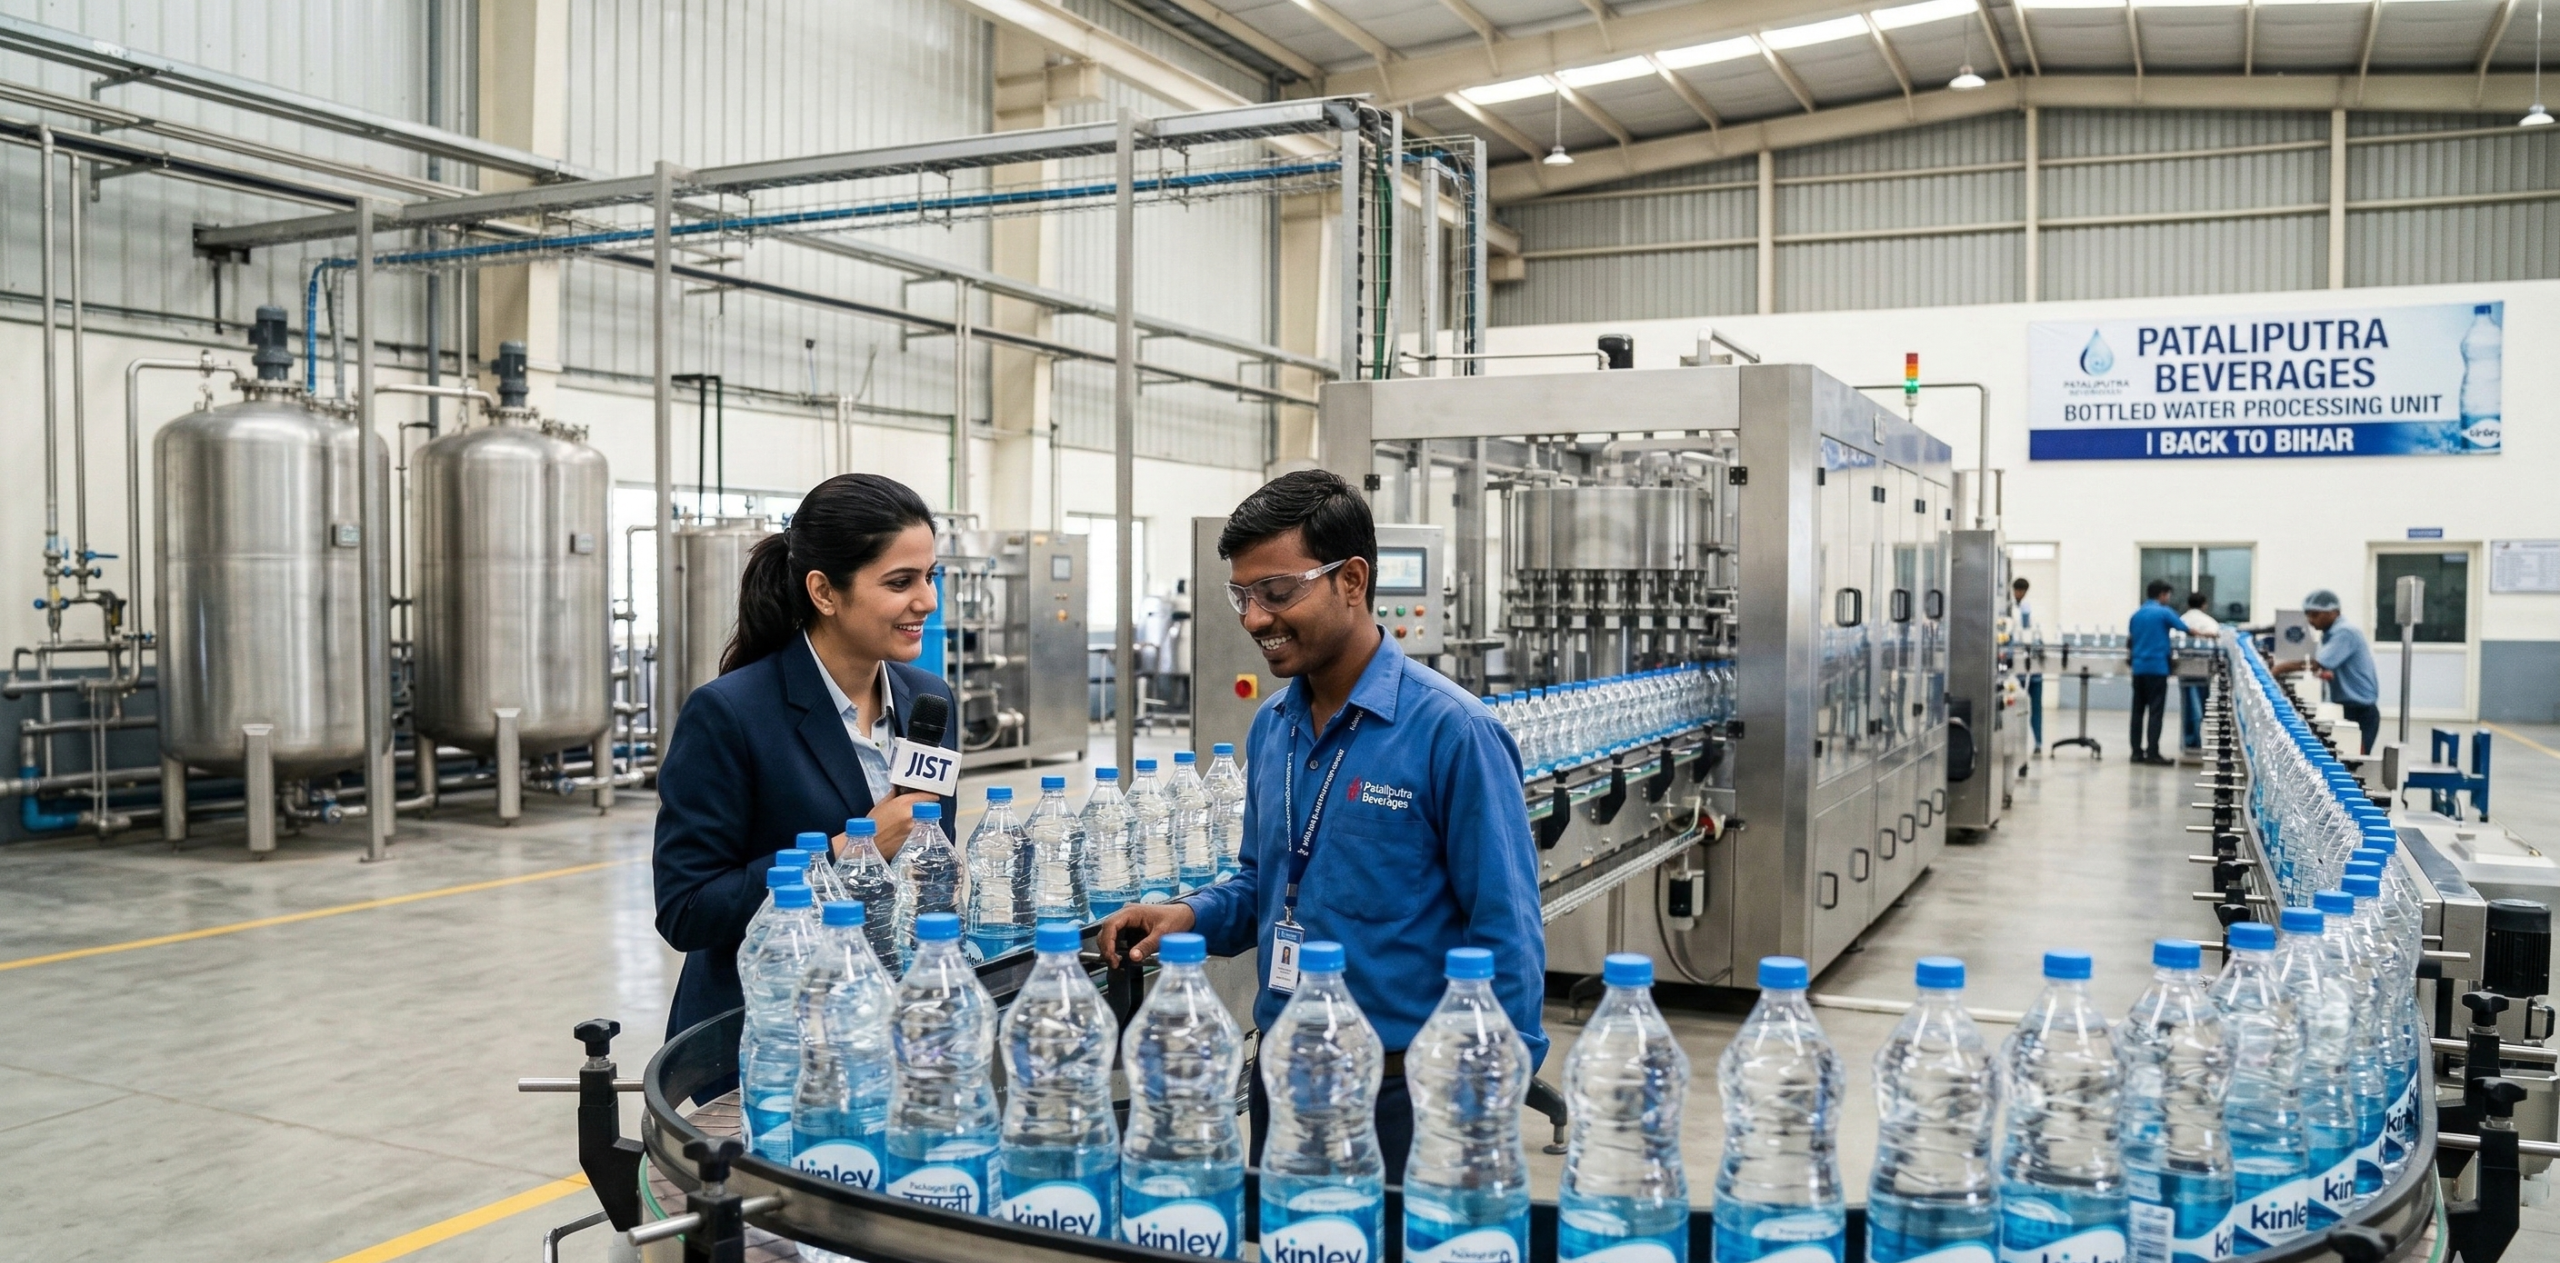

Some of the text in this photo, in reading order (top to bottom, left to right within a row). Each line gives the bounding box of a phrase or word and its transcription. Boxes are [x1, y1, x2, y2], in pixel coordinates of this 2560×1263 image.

[2138, 318, 2389, 356] PATALIPUTRA
[2156, 357, 2375, 393] BEVERAGES
[2064, 395, 2442, 422] BOTTLED WATER PROCESSING UNIT
[2160, 430, 2229, 454] BACK
[2234, 430, 2268, 453] TO
[2274, 427, 2354, 452] BIHAR
[905, 752, 952, 781] JIST
[1362, 792, 1409, 810] Beverages
[2323, 1173, 2354, 1202] kin
[1012, 1204, 1095, 1236] kinley
[2251, 1201, 2307, 1230] kinle
[1137, 1223, 1222, 1258] kinley
